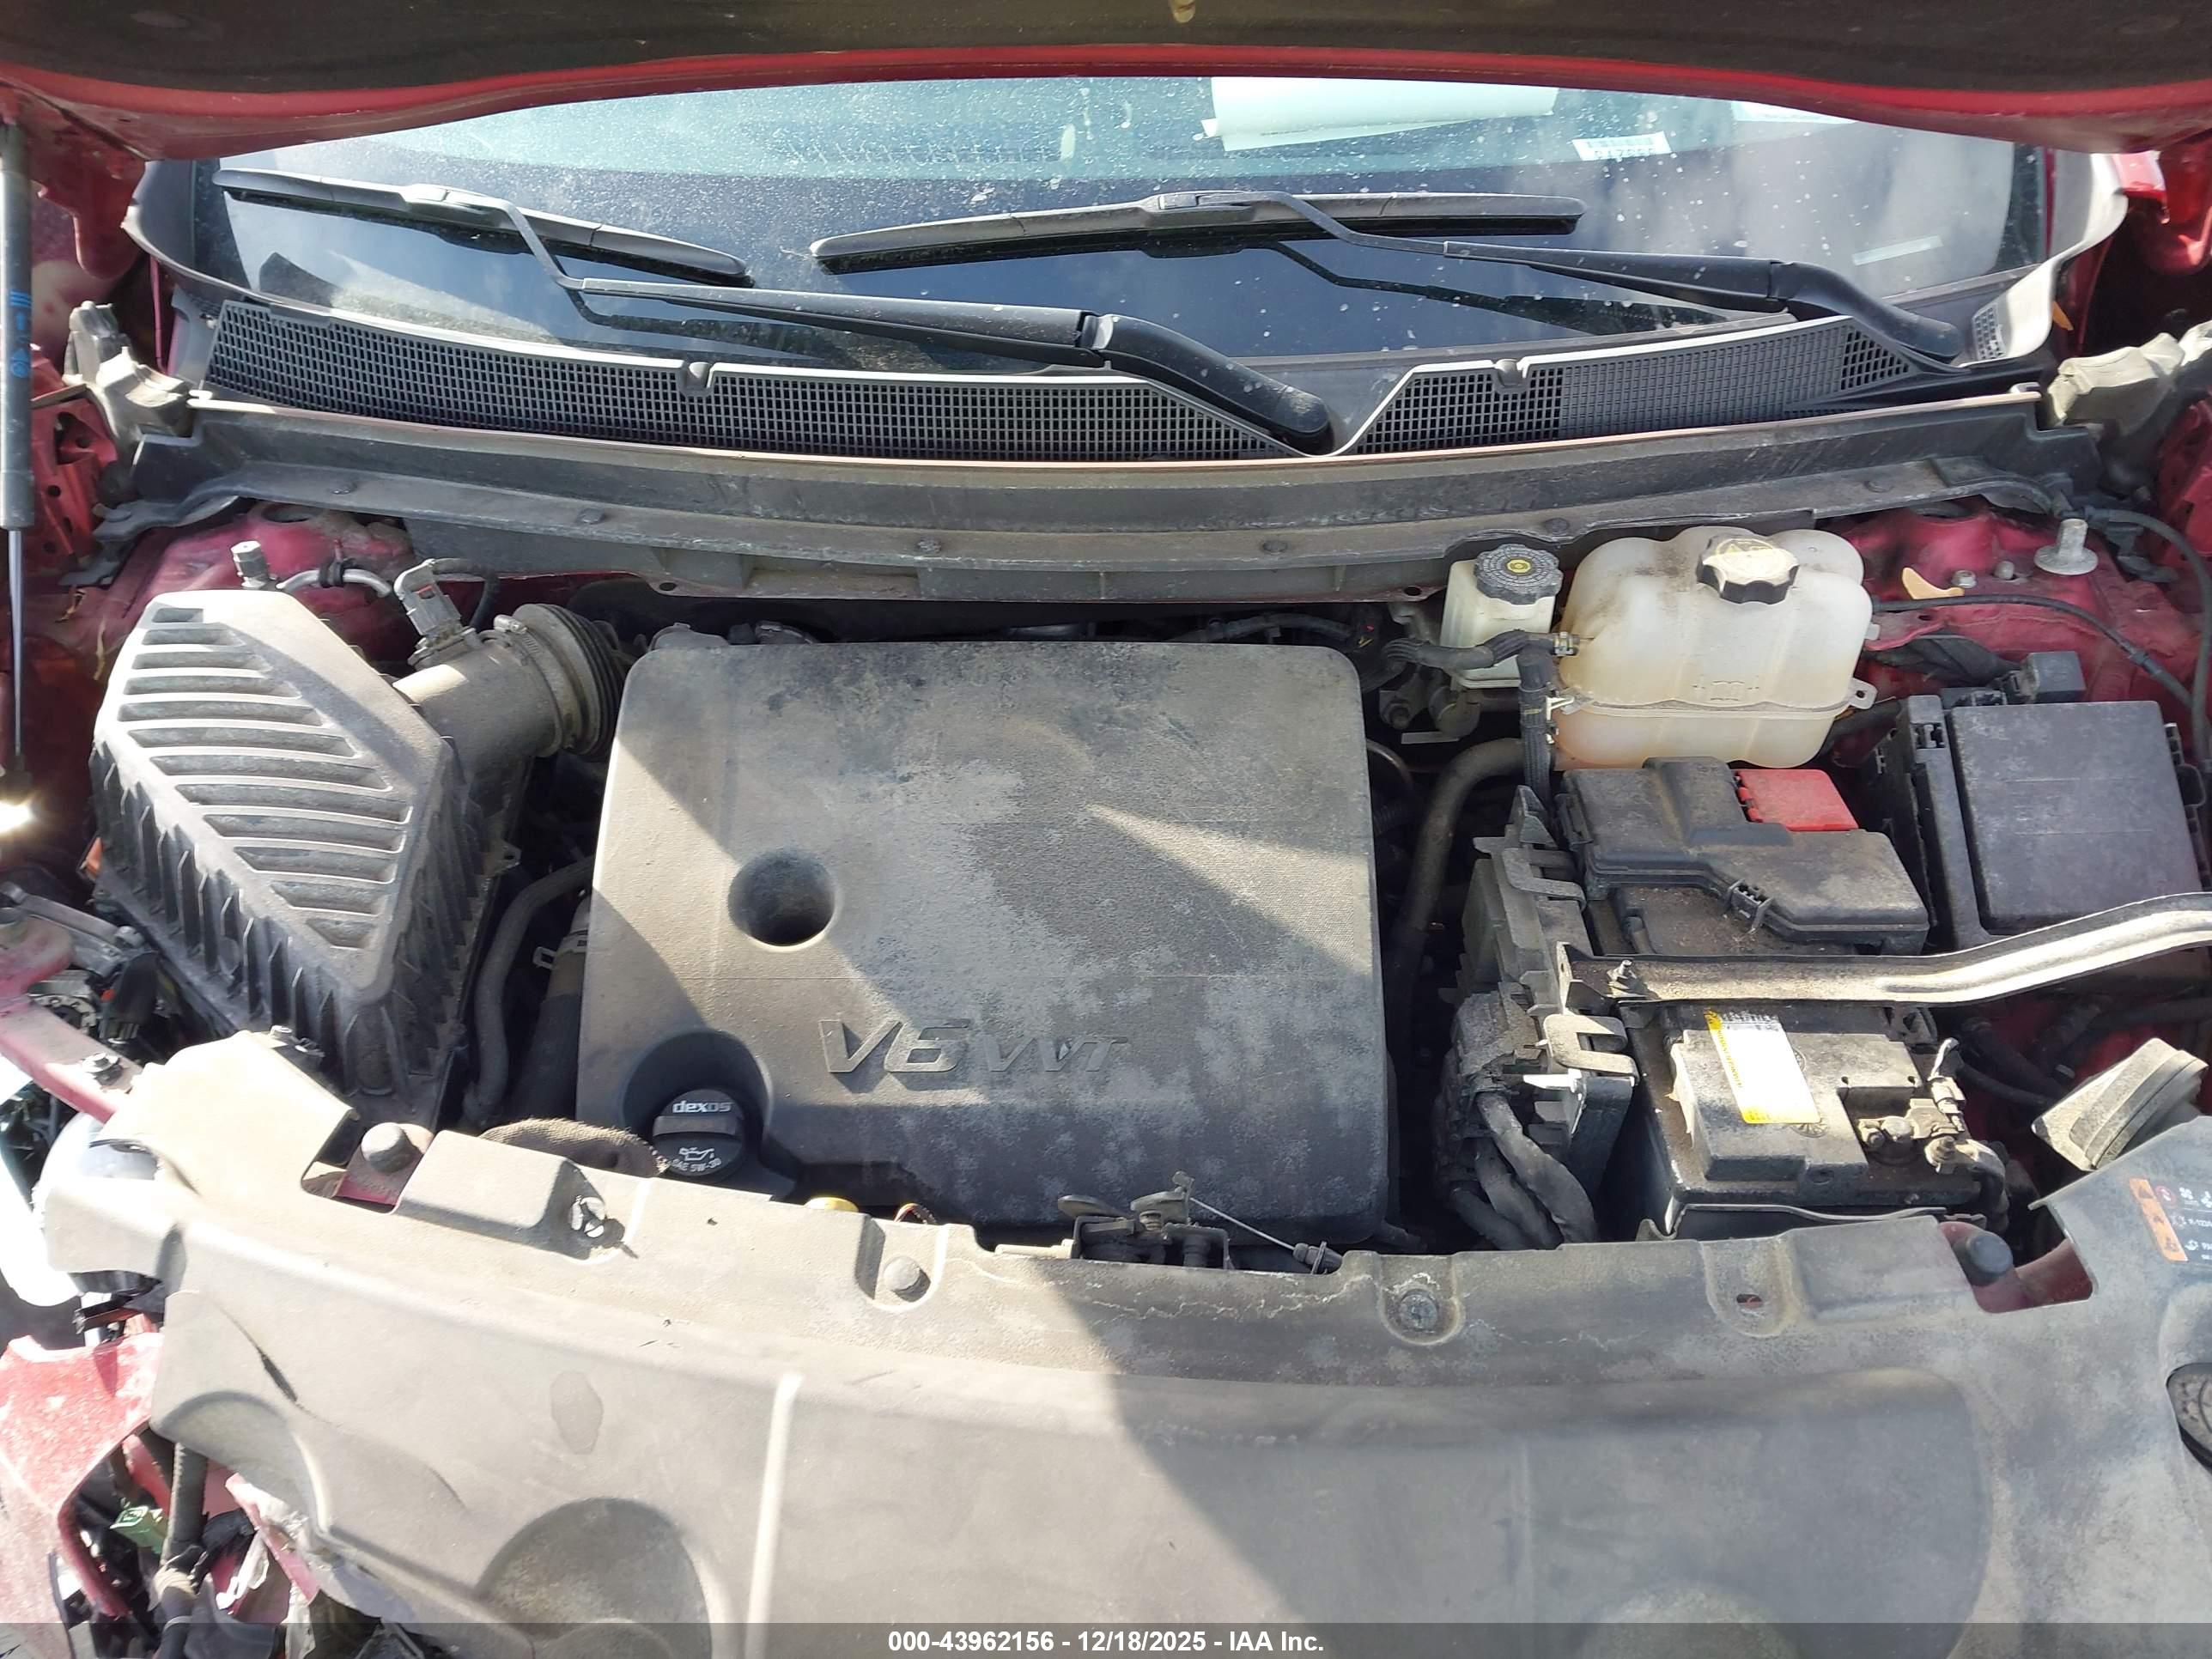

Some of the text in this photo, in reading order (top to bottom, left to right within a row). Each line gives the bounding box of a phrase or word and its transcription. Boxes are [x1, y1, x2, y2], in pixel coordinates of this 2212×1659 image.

[818, 1018, 1129, 1073] V6 VVT
[672, 1100, 734, 1113] dexos
[671, 1158, 723, 1173] SAE 5W-30
